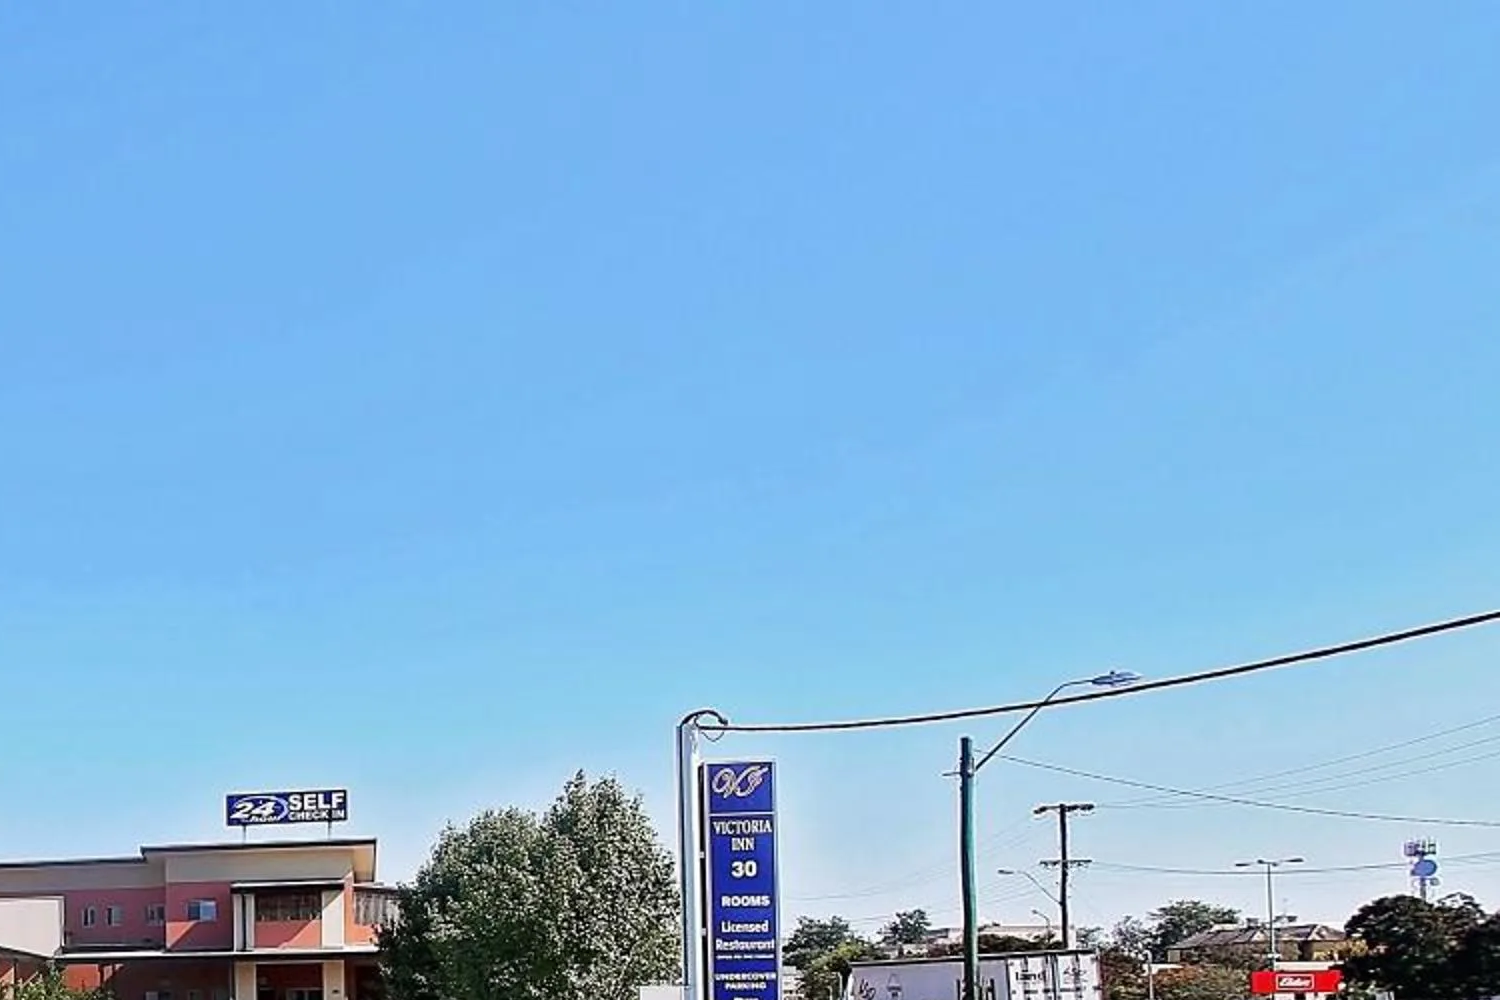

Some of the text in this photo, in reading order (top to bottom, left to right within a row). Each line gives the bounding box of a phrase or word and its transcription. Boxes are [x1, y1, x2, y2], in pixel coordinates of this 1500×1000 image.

[230, 792, 345, 819] 24 SELF
[288, 810, 329, 821] CHECK
[331, 809, 345, 819] IN
[712, 820, 773, 835] VICTORIA
[731, 837, 755, 851] INN
[731, 860, 757, 878] 30
[721, 895, 771, 907] ROOMS
[721, 920, 769, 933] Licensed
[715, 938, 775, 951] Restaurant
